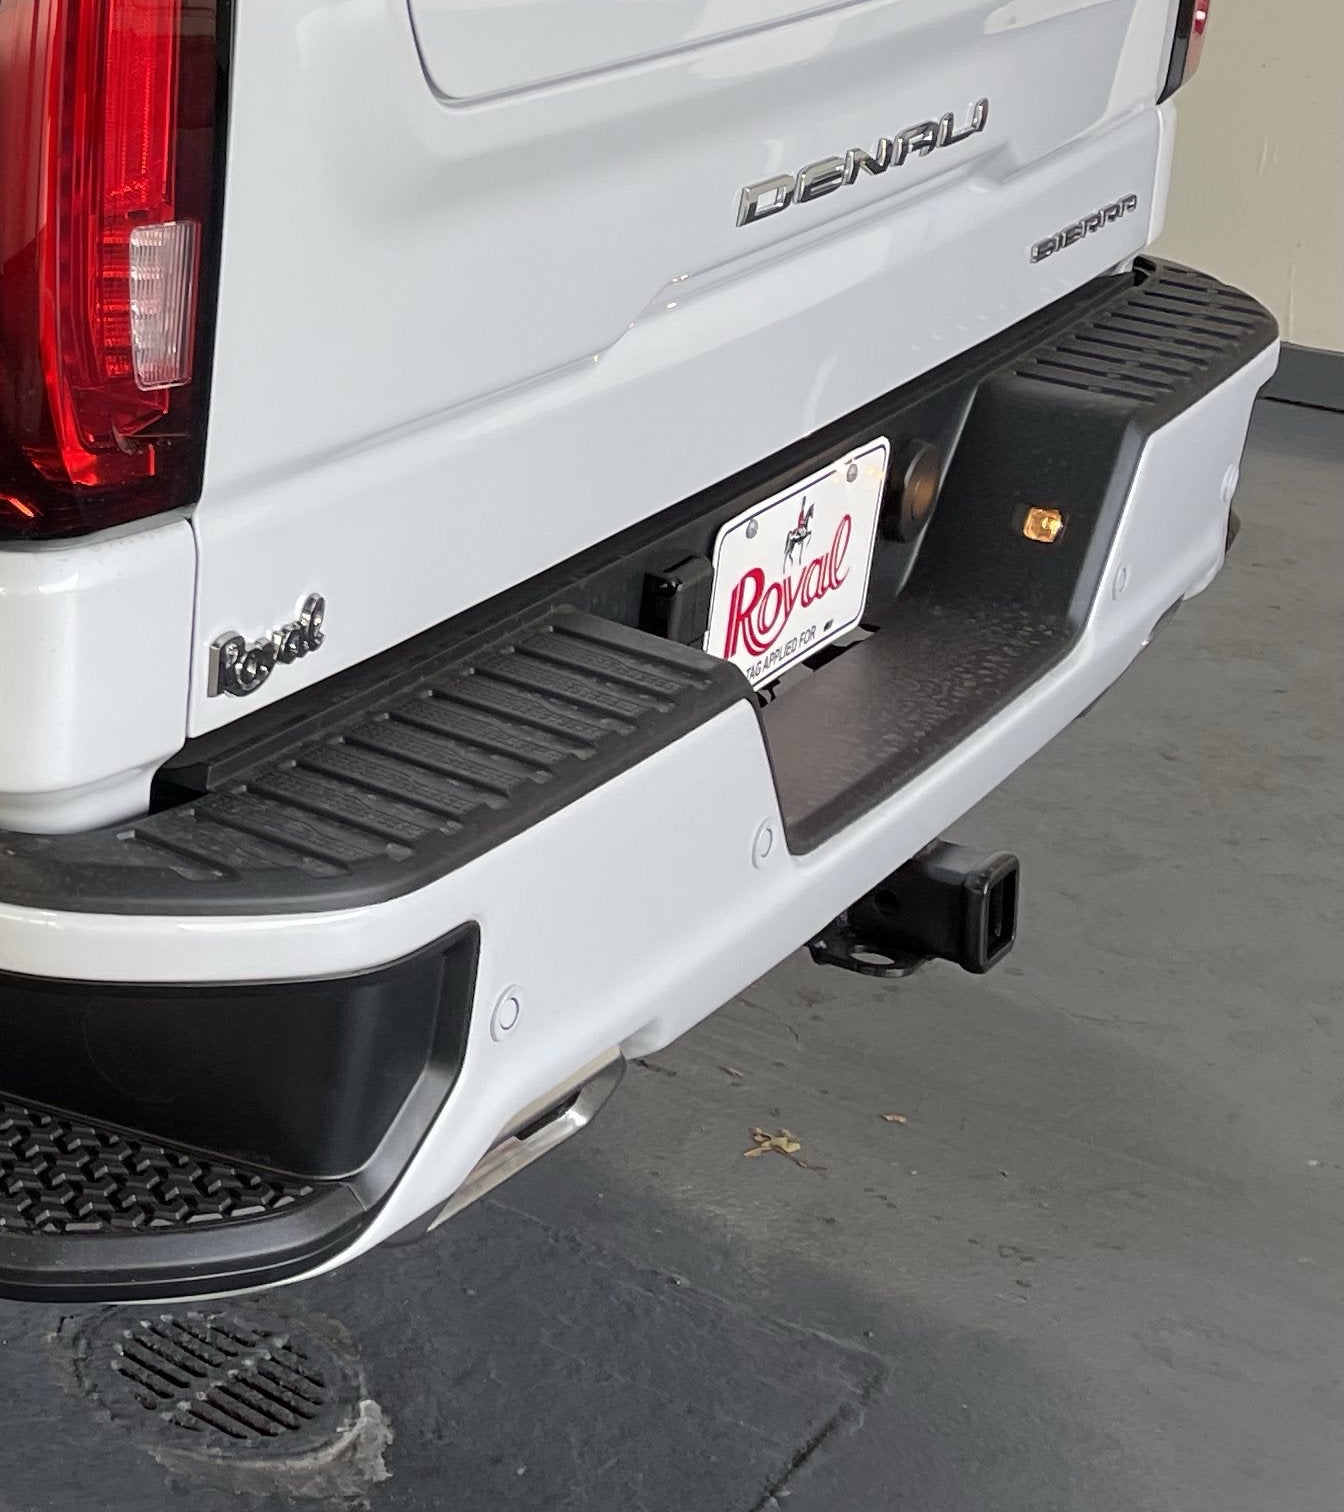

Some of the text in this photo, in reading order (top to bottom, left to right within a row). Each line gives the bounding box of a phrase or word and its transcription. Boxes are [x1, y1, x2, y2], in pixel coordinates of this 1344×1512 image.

[736, 97, 989, 228] DENALI
[1029, 193, 1138, 265] SIERRA
[723, 513, 852, 660] Royal
[746, 625, 816, 680] TAG APPLIED FOR
